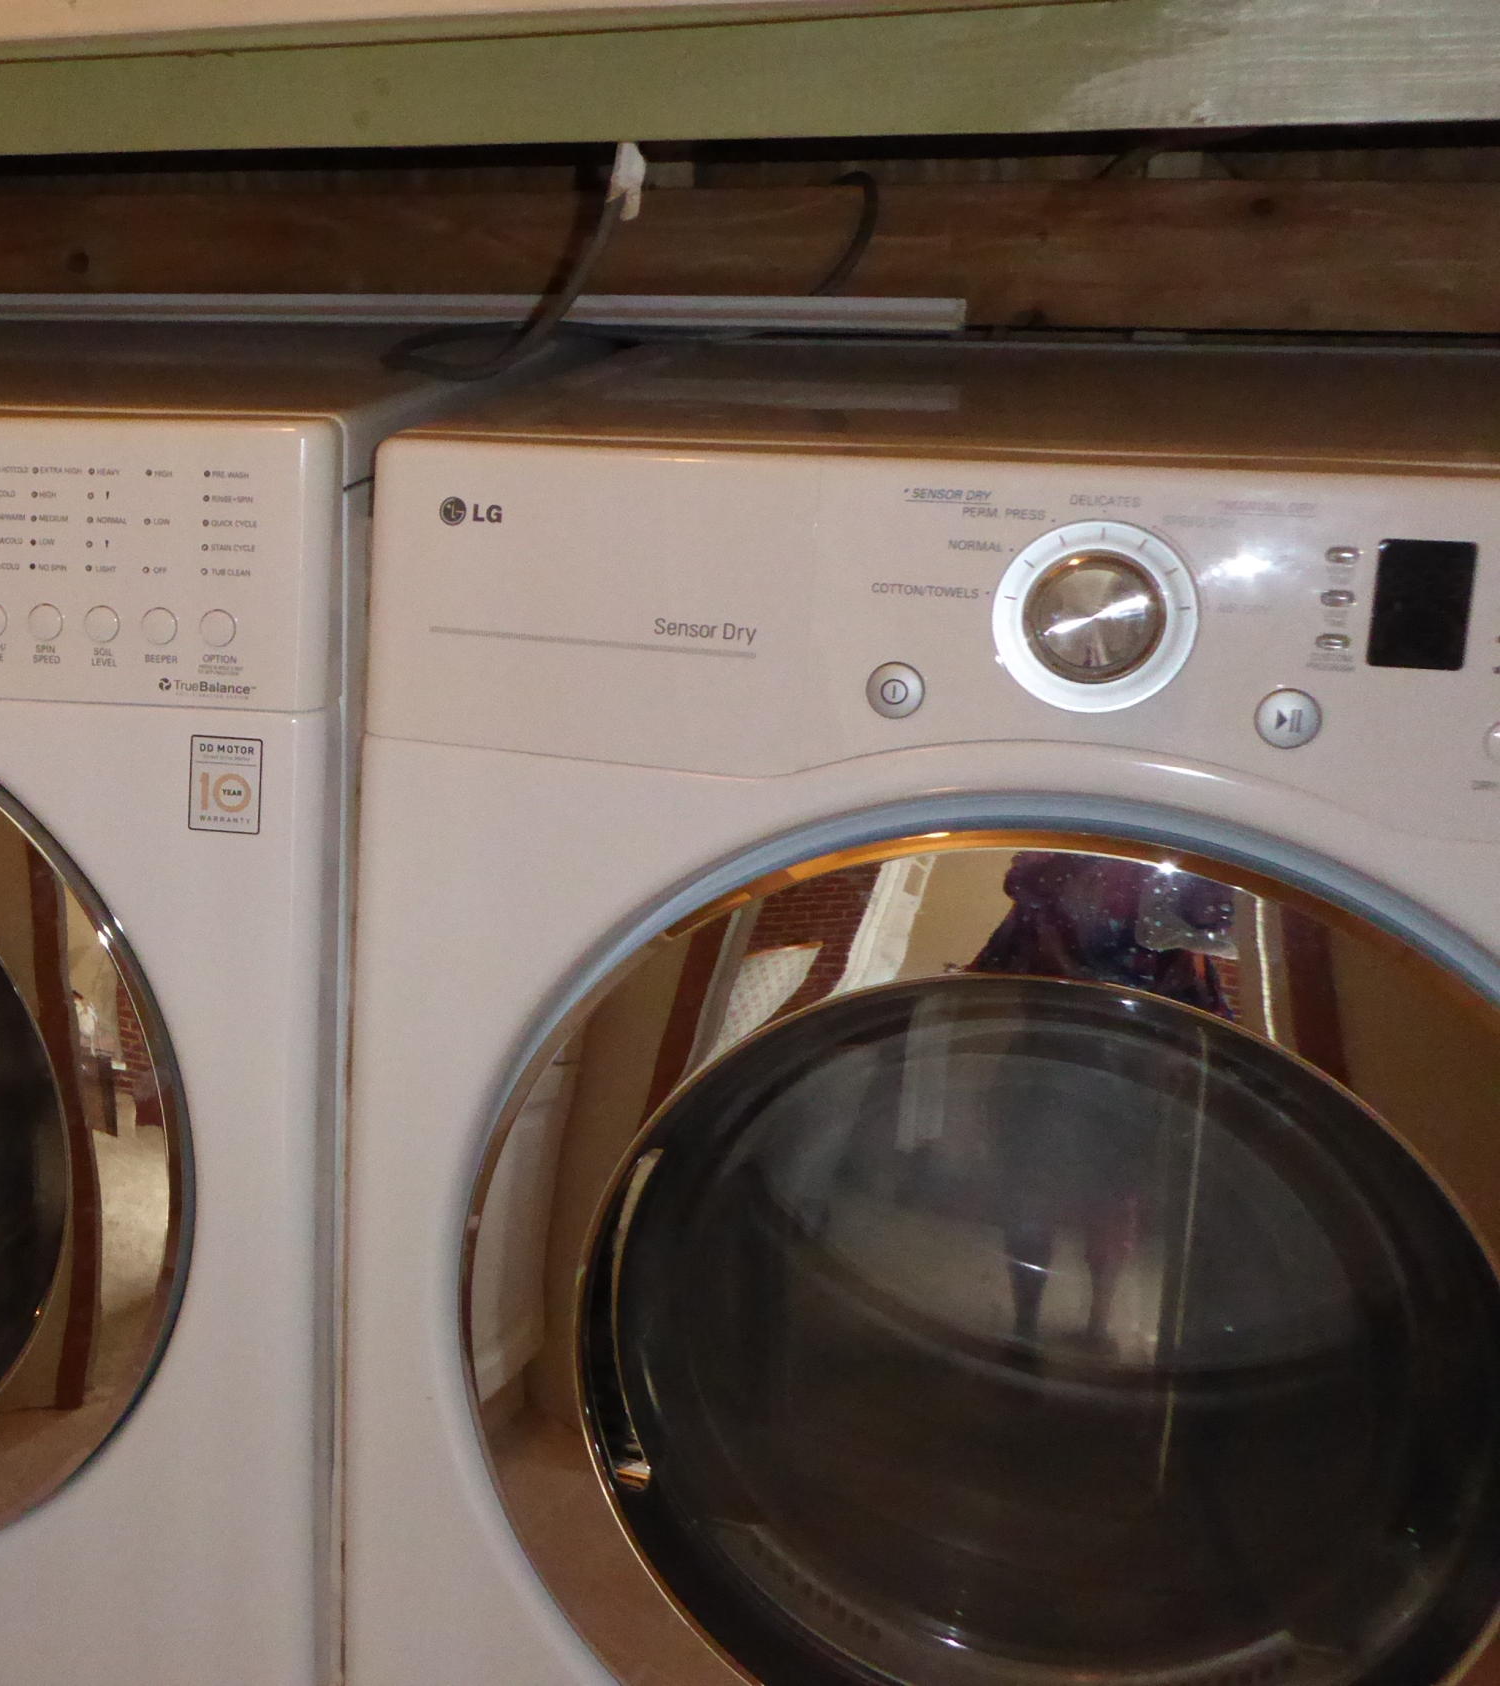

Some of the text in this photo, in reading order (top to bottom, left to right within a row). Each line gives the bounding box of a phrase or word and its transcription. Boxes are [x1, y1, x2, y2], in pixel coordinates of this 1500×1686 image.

[911, 487, 992, 501] SENSOR DRY
[1069, 494, 1141, 508] DELICATES
[472, 503, 503, 524] LG
[1004, 508, 1046, 521] PRESS
[234, 520, 257, 528] CYCLE
[39, 538, 55, 546] LOW
[948, 540, 1002, 553] NORMAL
[233, 543, 255, 552] CYCLE
[227, 569, 251, 577] CLEAN
[871, 582, 980, 599] COTTON/TOWELS
[653, 617, 757, 646] Sensor Dry
[35, 645, 56, 654] SPIN
[93, 647, 112, 656] SOIL
[33, 655, 60, 664] SPEED
[91, 658, 117, 667] LEVEL
[144, 654, 178, 664] BEEPER
[202, 654, 237, 664] OPTION
[199, 743, 254, 755] DD MOTOR
[200, 772, 252, 813] 10
[222, 788, 242, 796] YEAR
[199, 815, 251, 824] WARRANTY
